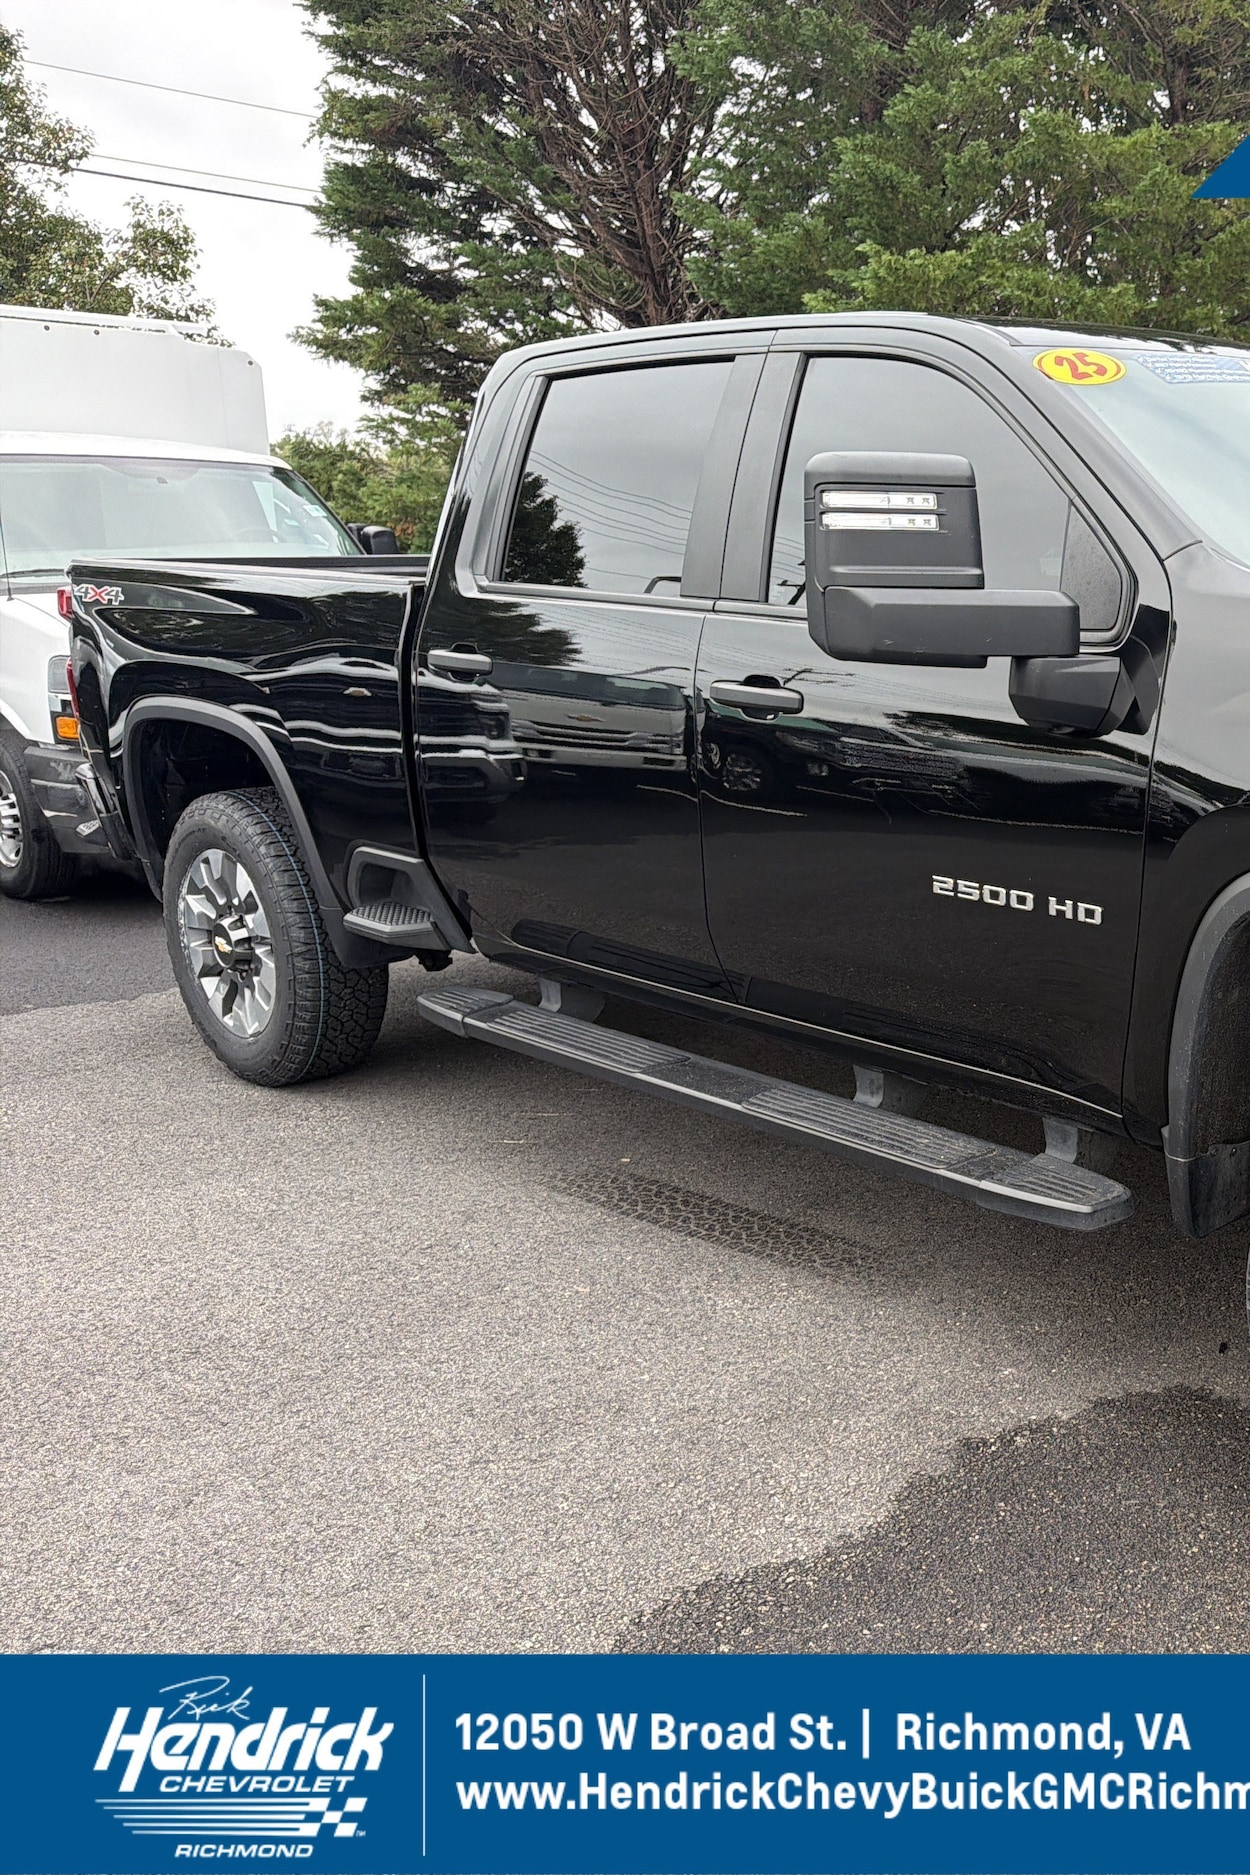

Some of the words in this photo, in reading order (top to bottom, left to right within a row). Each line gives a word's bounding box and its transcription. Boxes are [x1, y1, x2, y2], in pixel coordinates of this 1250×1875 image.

[1055, 352, 1109, 380] 25
[932, 875, 1035, 911] 2500
[1048, 896, 1103, 925] HD
